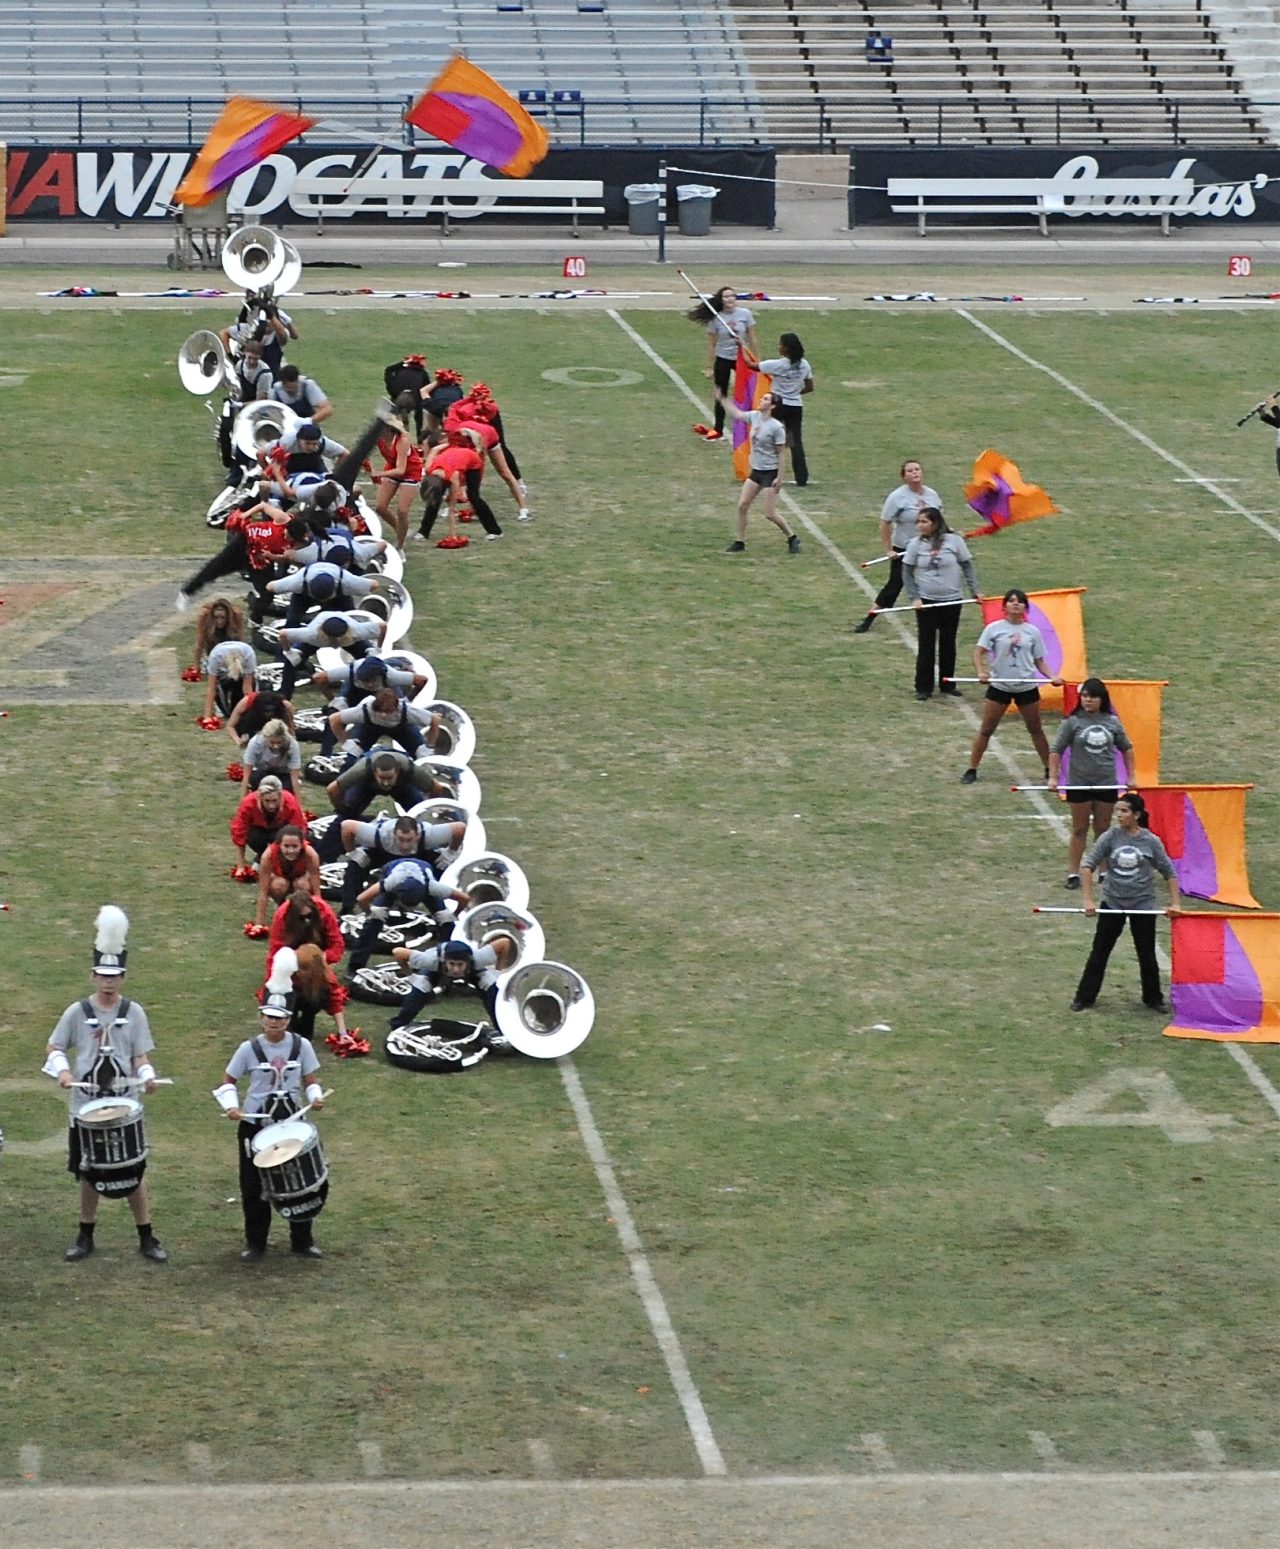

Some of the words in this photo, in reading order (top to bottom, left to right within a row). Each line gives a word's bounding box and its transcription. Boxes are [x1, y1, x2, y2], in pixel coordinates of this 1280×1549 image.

[76, 152, 499, 218] WIDCATS
[566, 258, 586, 276] 40
[1230, 257, 1251, 276] 30
